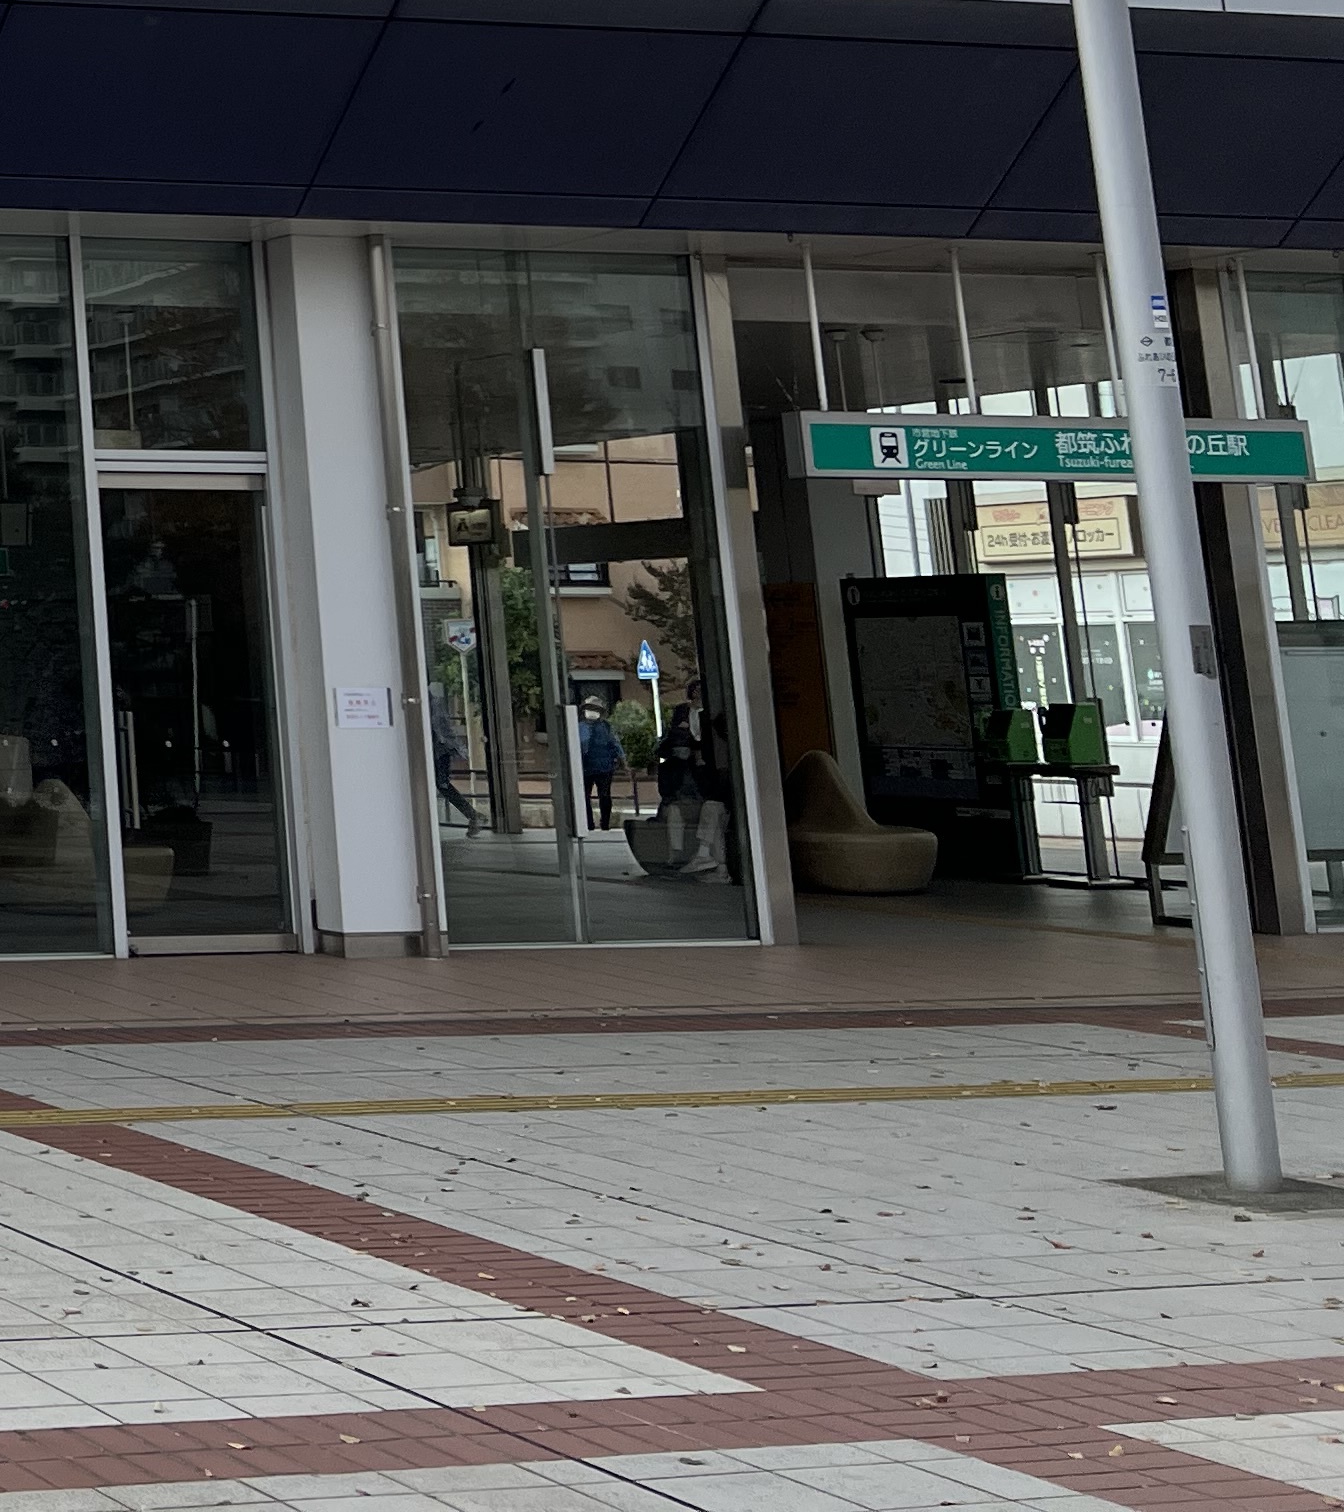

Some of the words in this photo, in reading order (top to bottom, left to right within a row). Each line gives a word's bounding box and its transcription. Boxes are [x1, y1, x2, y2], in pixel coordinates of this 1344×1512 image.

[913, 438, 1039, 459] グリーンライン
[1055, 431, 1250, 457] 都筑ふの丘駅
[915, 458, 945, 470] Green
[947, 459, 968, 471] Line
[1058, 455, 1134, 469] Tsuzuki-furea
